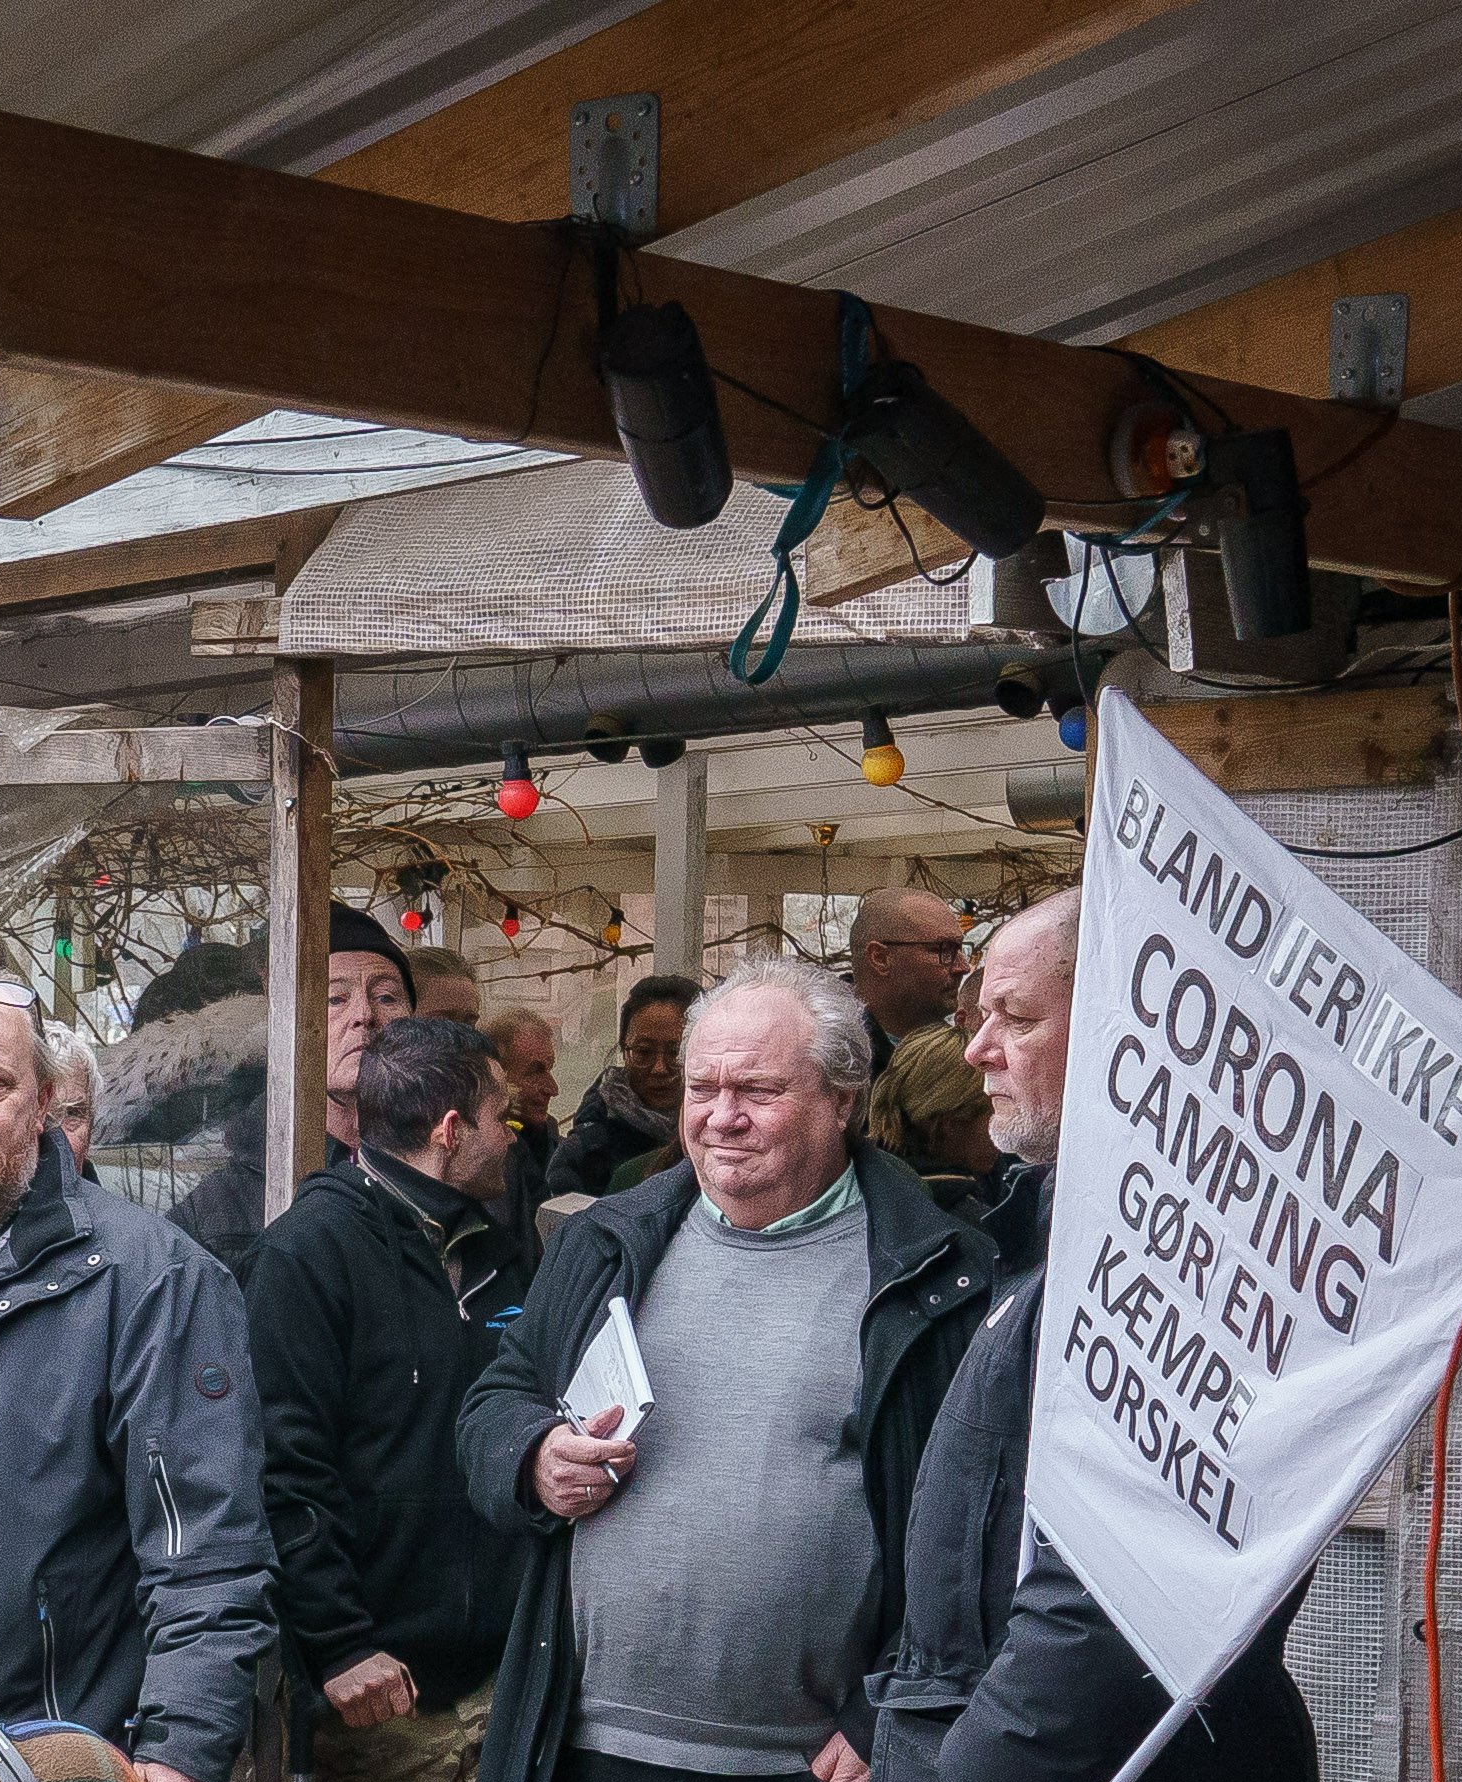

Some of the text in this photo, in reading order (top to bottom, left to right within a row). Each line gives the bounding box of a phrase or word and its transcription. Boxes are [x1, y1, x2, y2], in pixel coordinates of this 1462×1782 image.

[1116, 778, 1272, 959] BLAND
[1268, 925, 1367, 1047] JER
[1107, 1034, 1366, 1335] CAMPING
[1130, 933, 1400, 1264] CORONA
[1087, 1234, 1252, 1453] KÆMPE
[1119, 1161, 1293, 1376] GØR EN
[1064, 1305, 1242, 1551] FORSKEL
